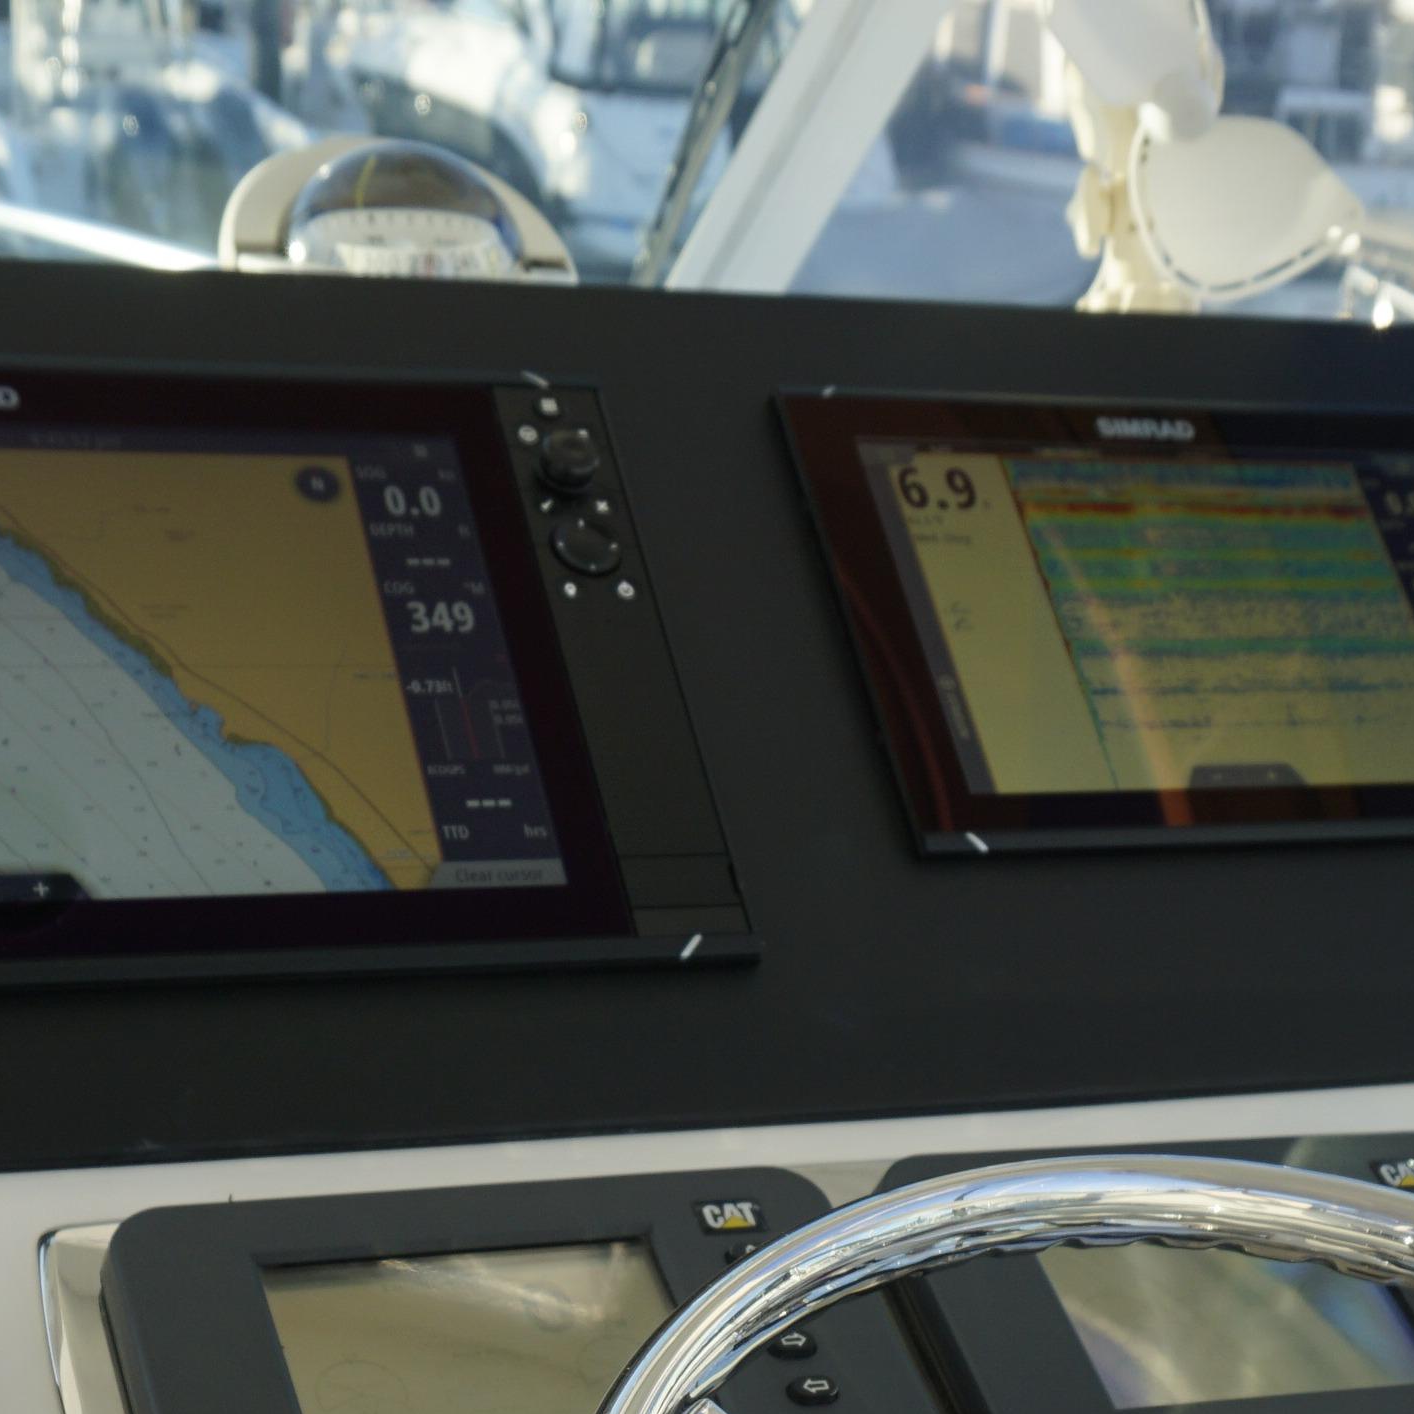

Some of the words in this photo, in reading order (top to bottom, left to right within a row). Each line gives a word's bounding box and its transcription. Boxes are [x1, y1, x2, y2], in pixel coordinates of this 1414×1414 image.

[1096, 416, 1196, 441] SIMRAD
[898, 465, 978, 511] 6.9
[383, 485, 443, 518] 0.0
[370, 522, 415, 537] DEPTH
[406, 601, 476, 634] 349
[442, 824, 471, 839] TTD
[524, 824, 549, 839] hrs
[454, 867, 492, 884] Clear
[495, 868, 544, 882] cursor
[702, 1202, 757, 1229] CAT
